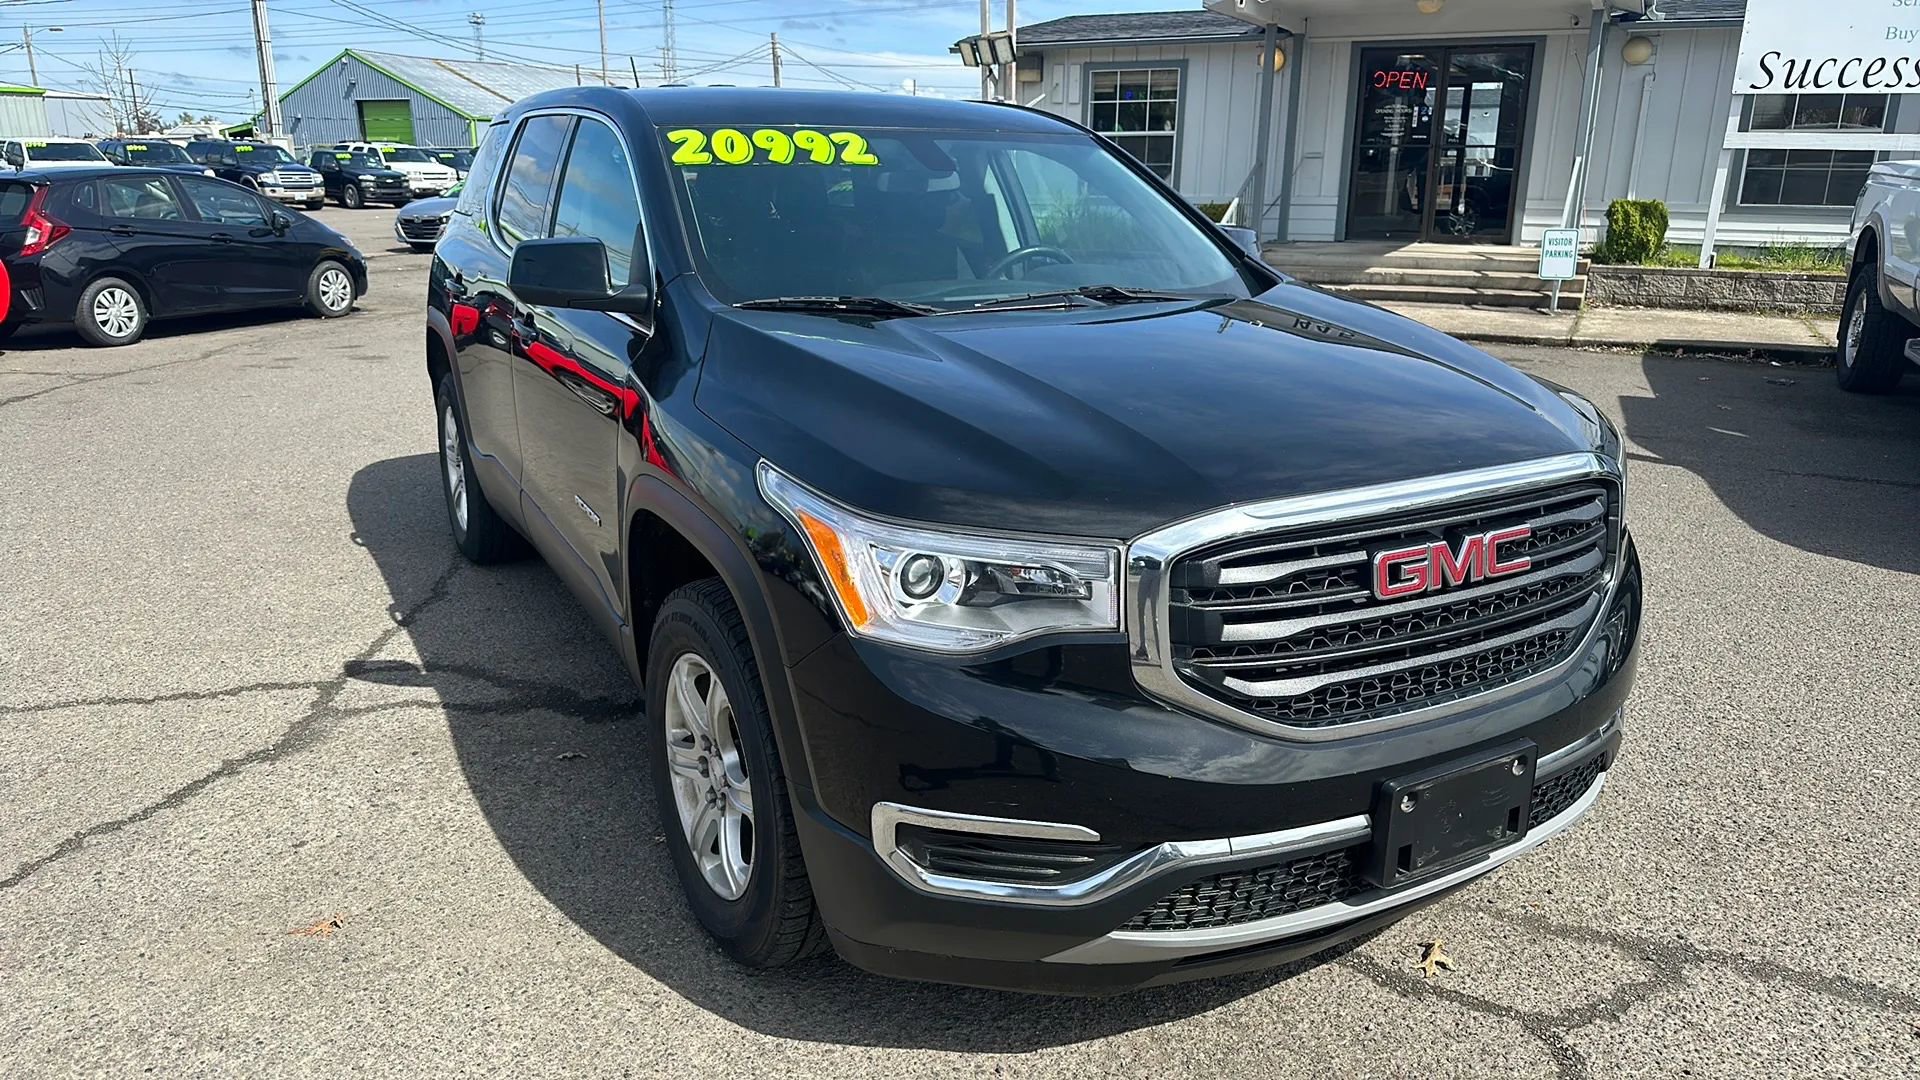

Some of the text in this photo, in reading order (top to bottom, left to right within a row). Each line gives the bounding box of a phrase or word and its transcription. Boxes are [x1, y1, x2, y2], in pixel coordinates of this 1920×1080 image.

[1885, 26, 1920, 44] Buy
[1374, 71, 1428, 89] OPEN
[666, 128, 879, 166] 20992
[1548, 237, 1573, 247] VISITOR
[1545, 249, 1574, 259] PARKING
[1373, 523, 1532, 601] GMC
